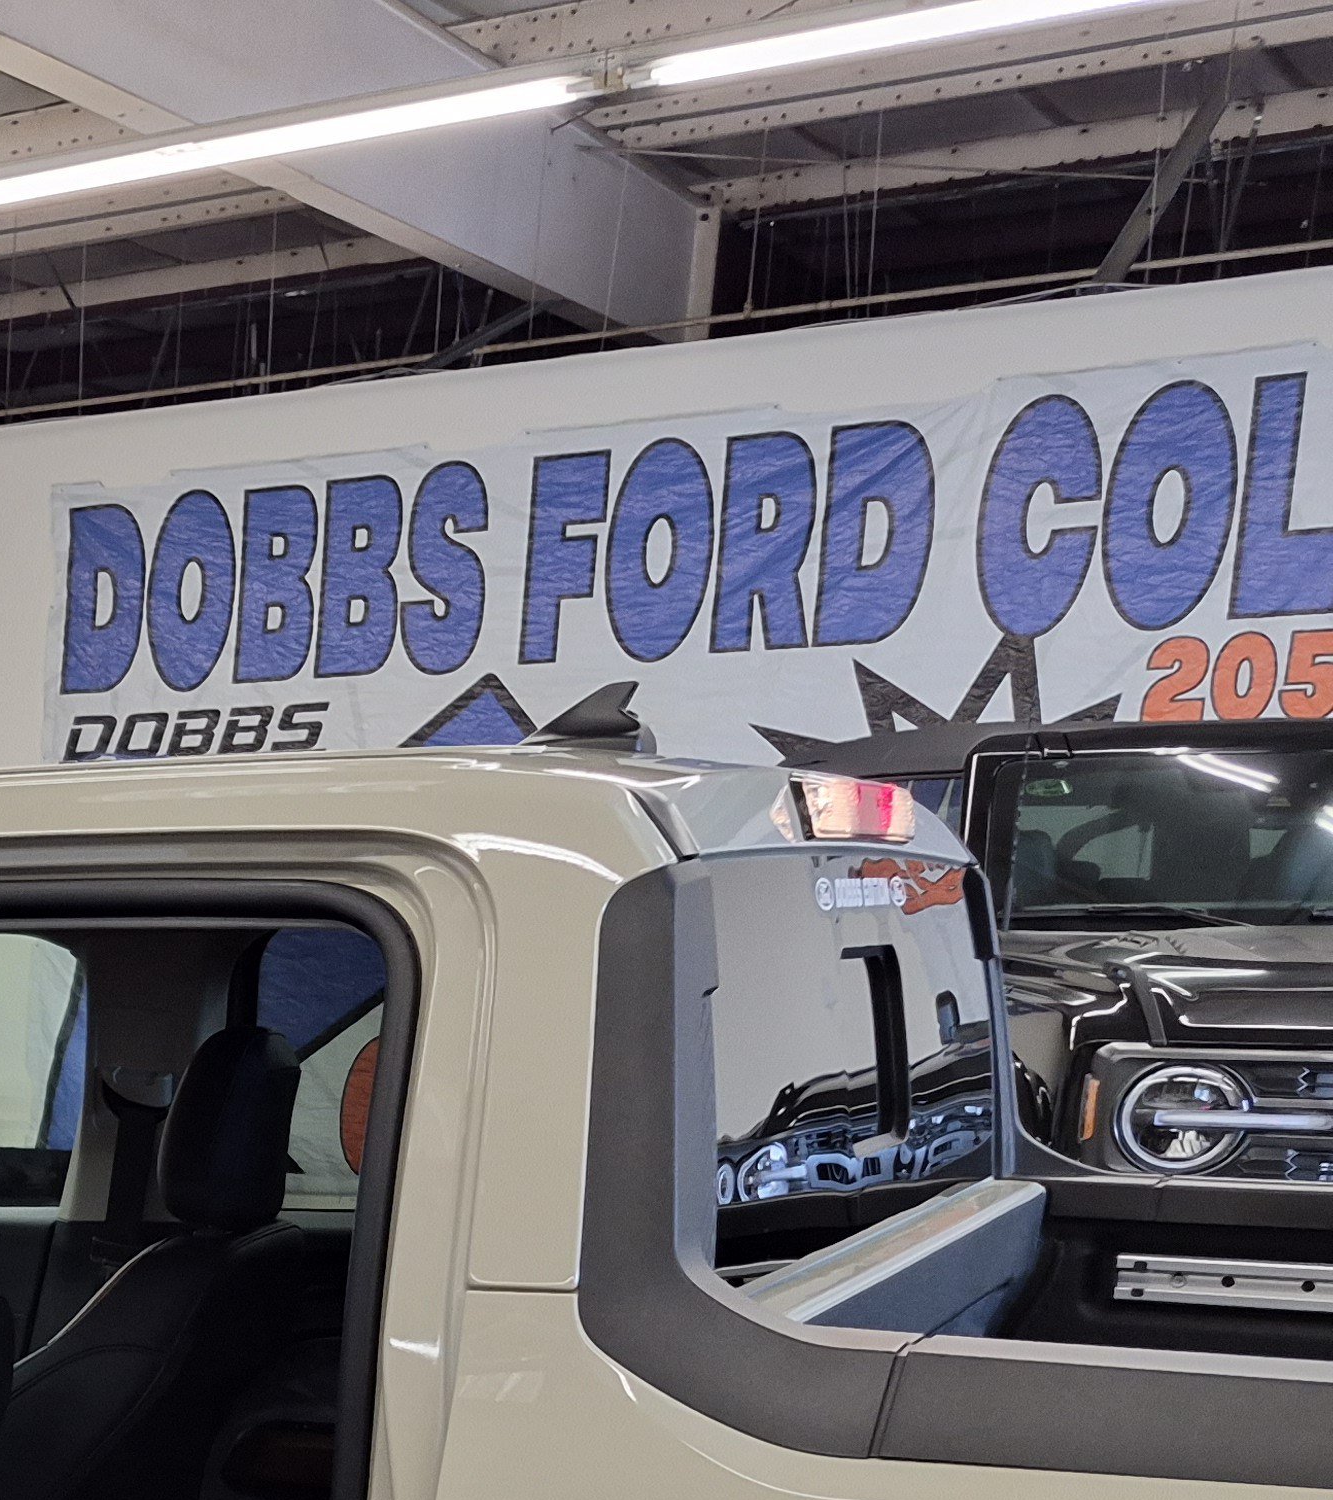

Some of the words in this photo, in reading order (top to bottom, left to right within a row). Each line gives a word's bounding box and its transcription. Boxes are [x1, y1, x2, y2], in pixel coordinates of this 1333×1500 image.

[60, 460, 489, 695] DOBBS
[518, 419, 935, 665] FORD
[976, 371, 1333, 637] COL
[1140, 629, 1333, 722] 205
[60, 701, 331, 763] DOBBS
